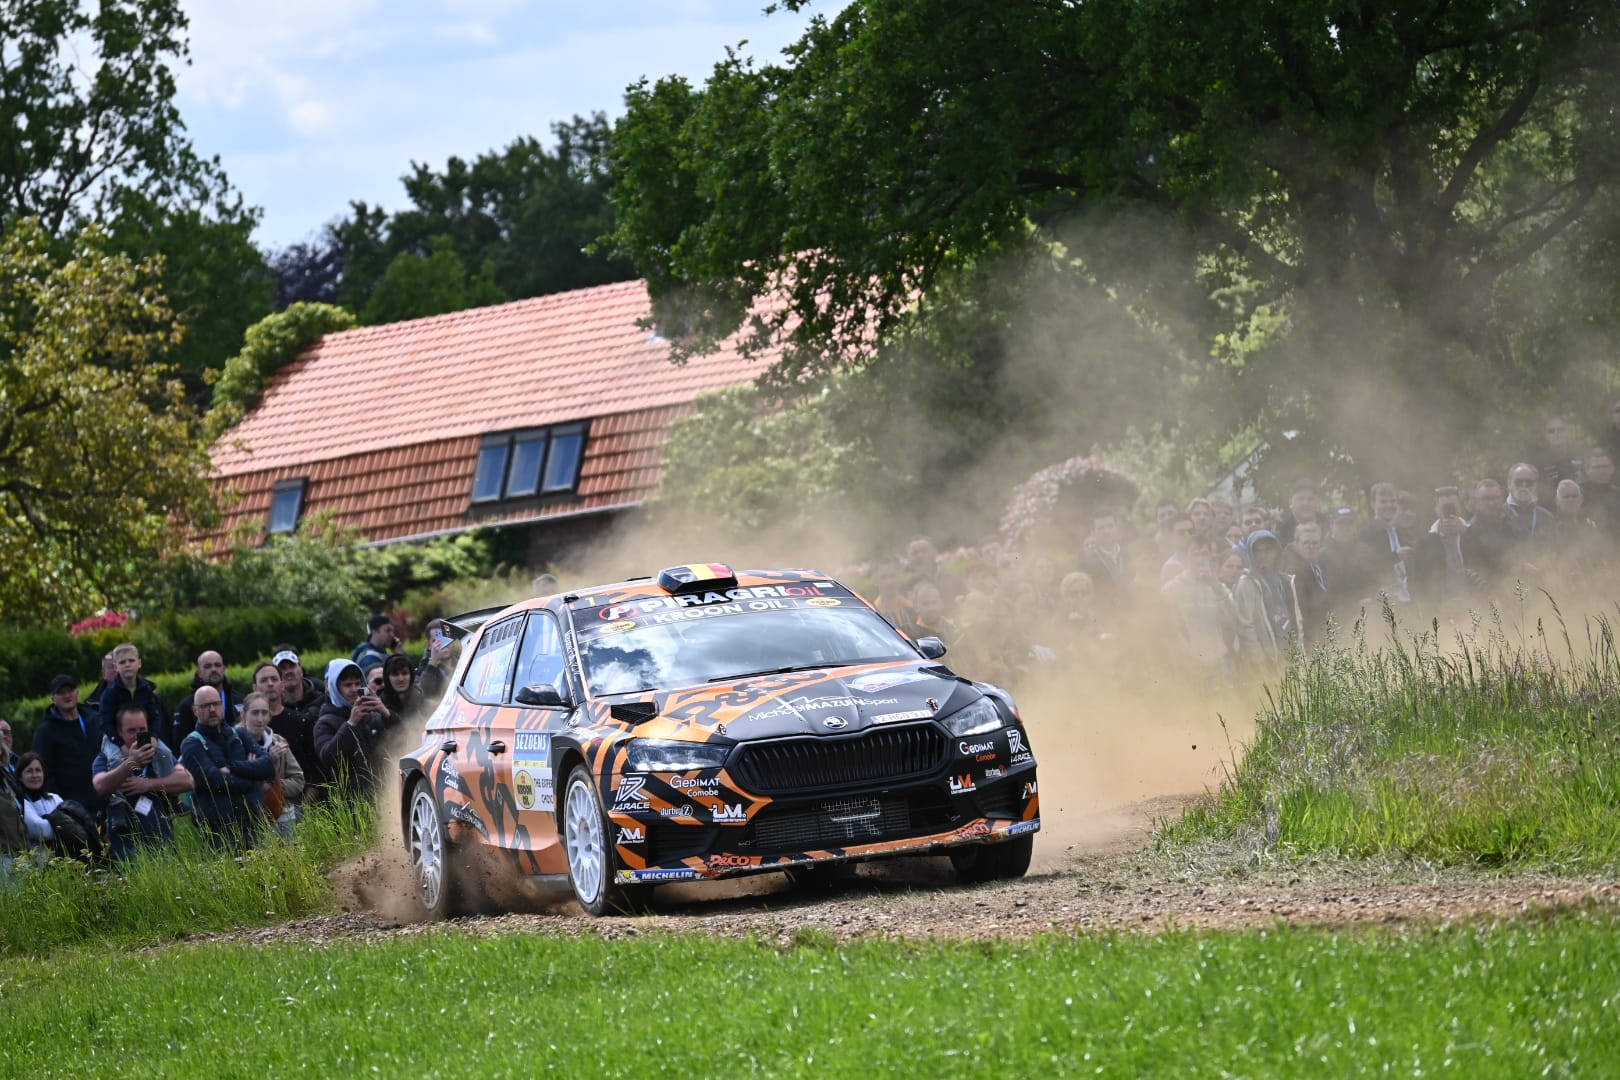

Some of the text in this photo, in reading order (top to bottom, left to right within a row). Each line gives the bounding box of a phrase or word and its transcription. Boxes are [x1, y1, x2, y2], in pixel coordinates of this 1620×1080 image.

[653, 605, 745, 624] KROON
[750, 598, 788, 611] OIL
[515, 734, 547, 750] SEZOENS
[1010, 822, 1040, 835] MICHELIN
[641, 871, 693, 880] MICHELIN
